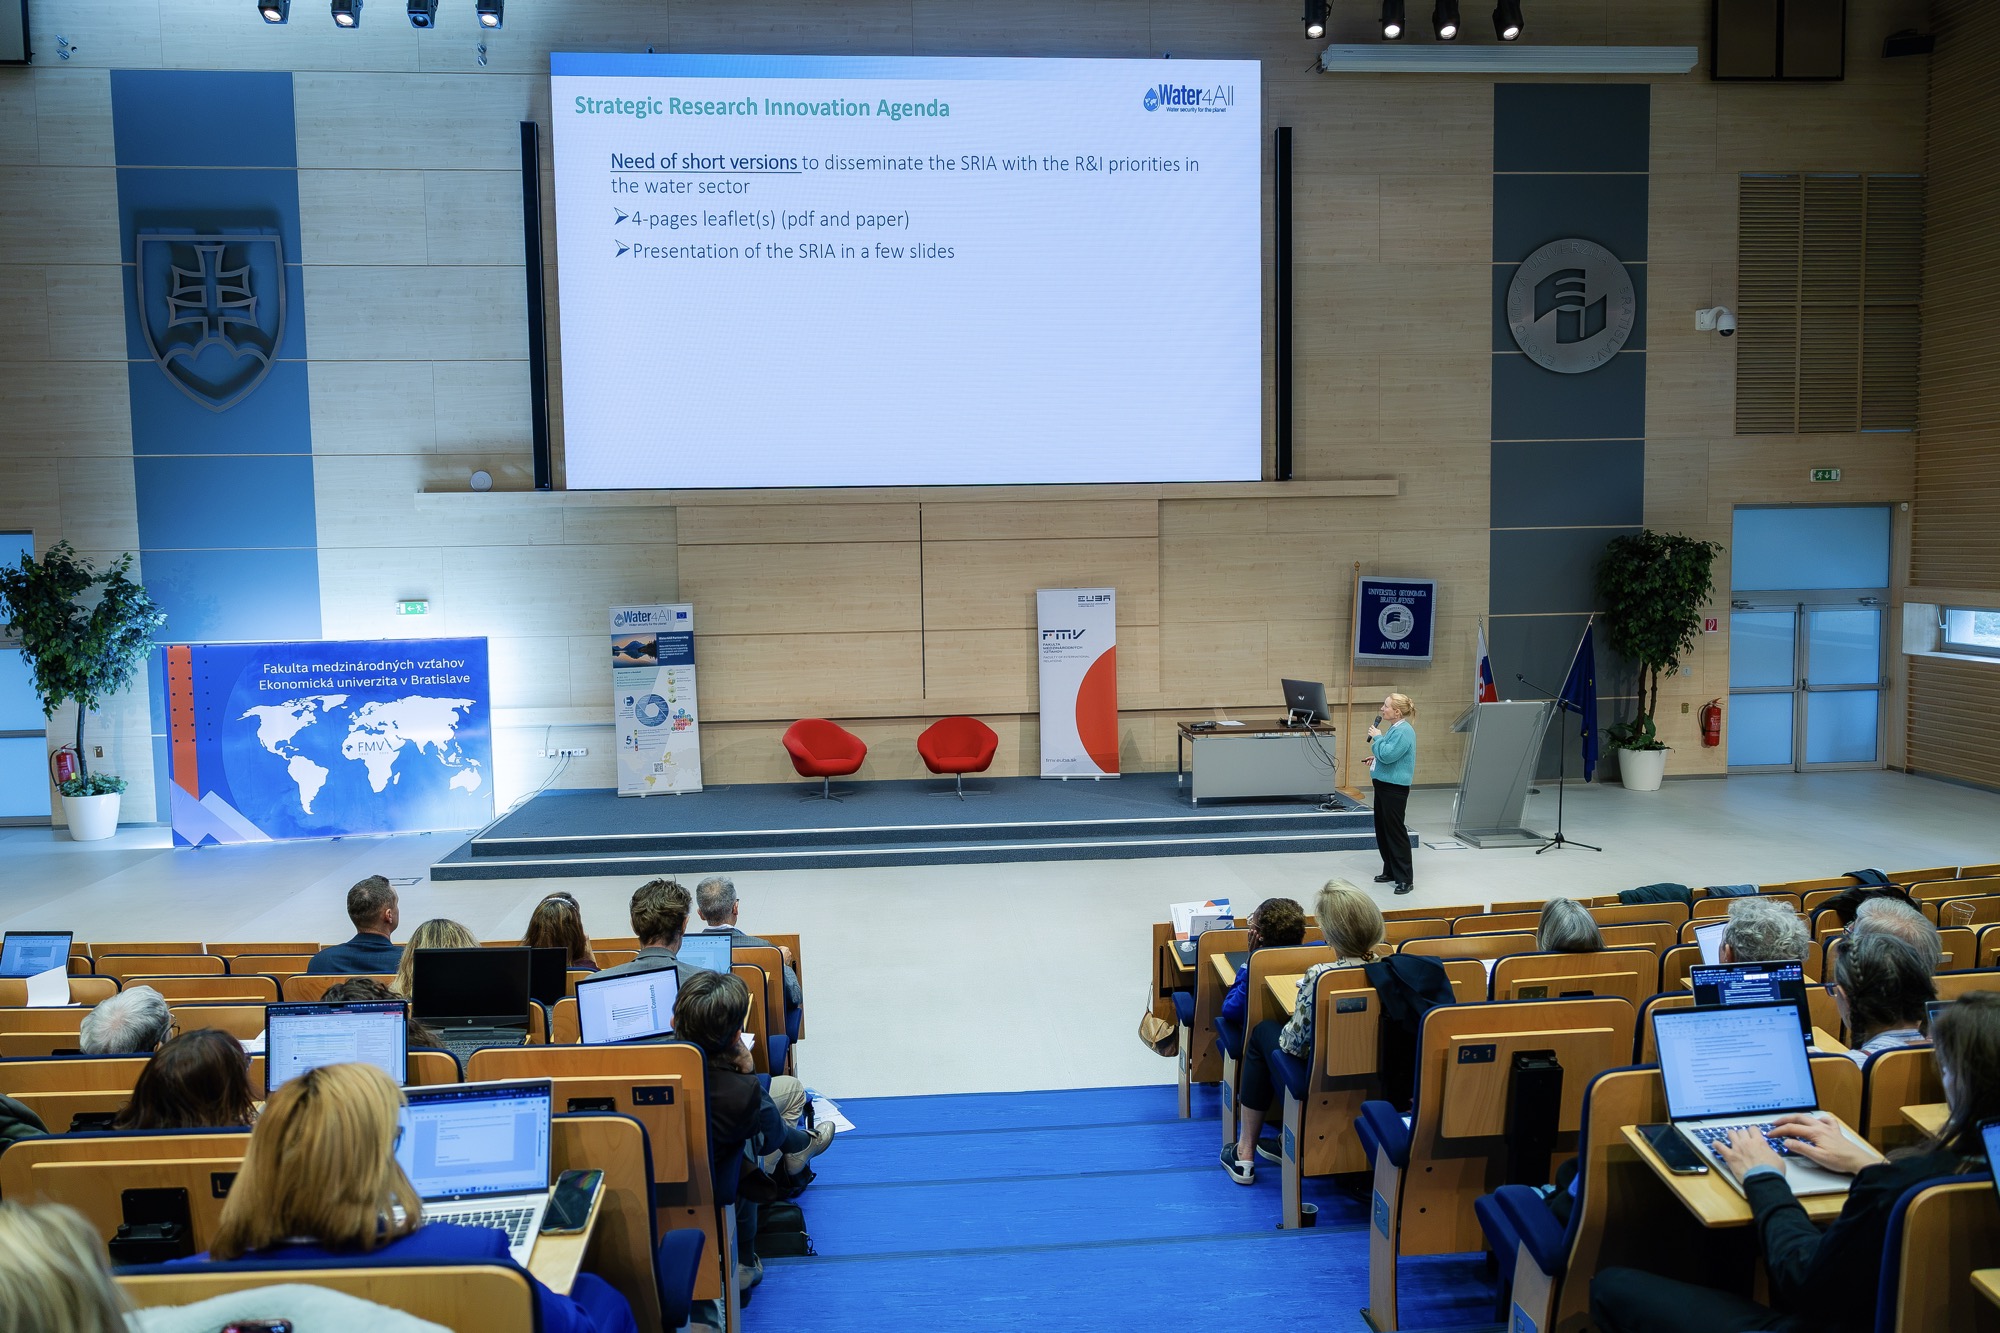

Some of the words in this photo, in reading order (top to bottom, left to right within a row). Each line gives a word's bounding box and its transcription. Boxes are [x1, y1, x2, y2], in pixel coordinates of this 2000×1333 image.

[1158, 84, 1234, 106] Water4All
[576, 96, 662, 120] Strategic
[670, 97, 757, 116] Research
[765, 98, 870, 117] Innovation
[877, 99, 950, 121] Agenda
[610, 153, 655, 170] Need
[660, 153, 678, 170] of
[682, 153, 726, 170] short
[730, 154, 798, 171] versions
[801, 156, 819, 171] to
[824, 154, 923, 171] disseminate
[929, 155, 955, 171] the
[961, 156, 998, 171] SRIA
[1002, 155, 1037, 171] with
[1043, 155, 1069, 171] the
[1075, 156, 1103, 172] R&I
[1109, 156, 1180, 175] priorities
[1185, 157, 1199, 172] in
[611, 177, 638, 193] the
[645, 178, 693, 194] water
[699, 179, 750, 194] sector
[632, 211, 698, 230] 4-pages
[704, 210, 776, 230] leaflet(s)
[782, 210, 815, 230] (pdf
[820, 211, 850, 227] and
[856, 210, 909, 231] paper)
[633, 243, 739, 259] Presentation
[744, 243, 762, 259] of
[766, 243, 793, 259] the
[799, 243, 836, 259] SRIA
[842, 243, 855, 259] in
[860, 247, 869, 259] a
[874, 243, 905, 259] few
[910, 243, 955, 259] slides
[1368, 588, 1397, 597] UNIVERSITAS
[1380, 596, 1415, 605] BRATISLAVENSIS
[624, 610, 672, 623] Water4All
[1042, 629, 1087, 640] FMV
[1380, 641, 1397, 650] ANNO
[1398, 641, 1410, 650] 1940
[263, 662, 308, 674] Fakulta
[312, 659, 415, 674] medzinárodných
[417, 658, 465, 670] vzťahov
[259, 677, 334, 691] Ekonomická
[337, 676, 398, 688] univerzita
[400, 677, 408, 686] v
[411, 673, 471, 685] Bratislave
[358, 741, 385, 752] FMV
[625, 735, 632, 745] 5
[1486, 1048, 1491, 1059] 1
[663, 1090, 669, 1101] 1
